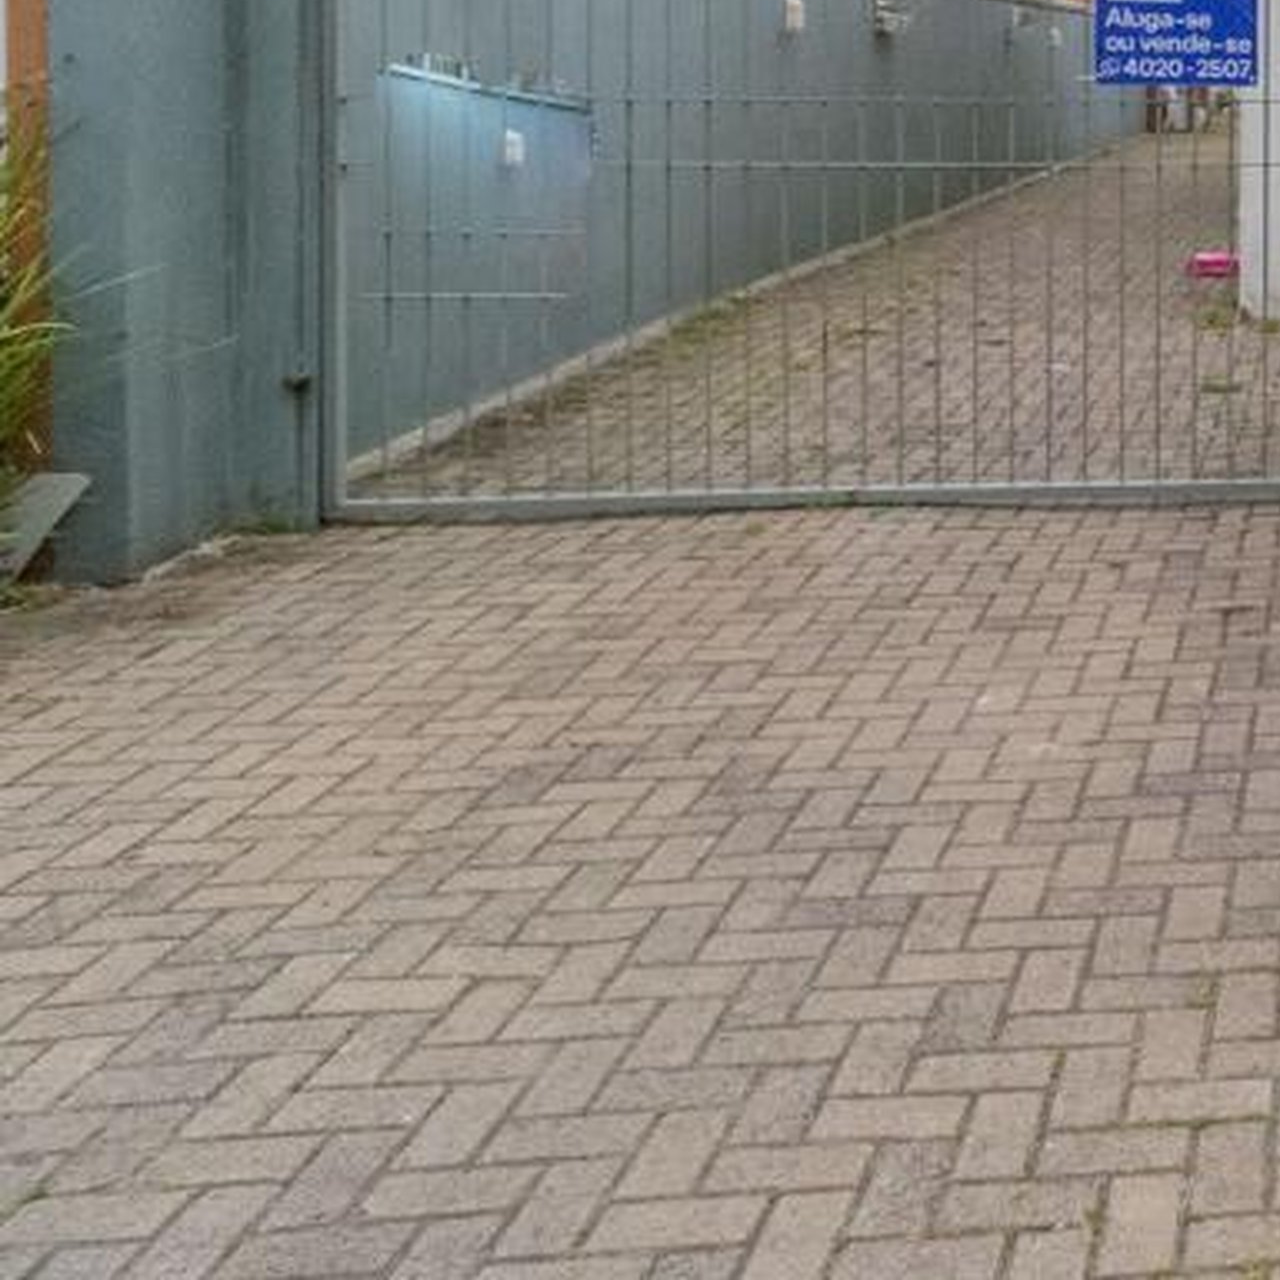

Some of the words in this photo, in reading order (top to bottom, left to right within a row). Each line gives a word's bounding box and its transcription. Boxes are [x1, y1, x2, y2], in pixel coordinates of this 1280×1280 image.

[1105, 6, 1212, 33] Aluga-se
[1105, 35, 1135, 52] ou
[1140, 33, 1252, 52] vende-se
